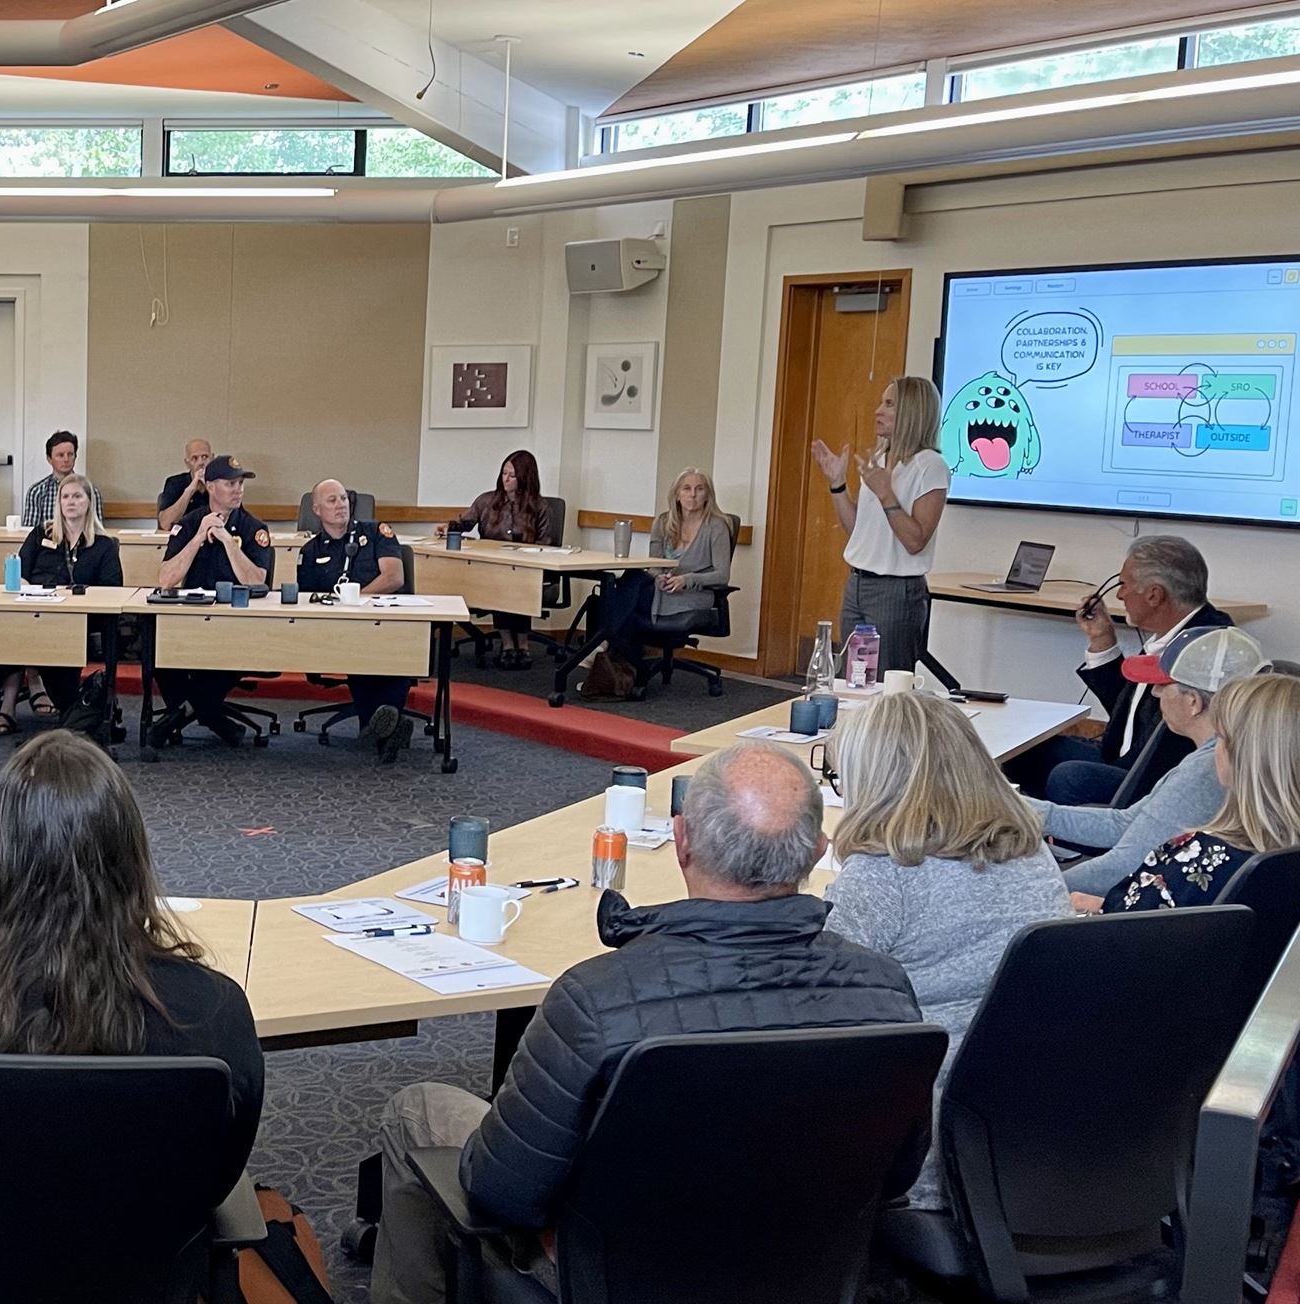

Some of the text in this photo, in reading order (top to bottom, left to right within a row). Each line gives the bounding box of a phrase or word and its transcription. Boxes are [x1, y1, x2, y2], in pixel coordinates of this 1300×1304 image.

[1016, 326, 1088, 336] COLLABORATION,
[1015, 338, 1078, 347] PARTNERSHIPS
[1013, 350, 1085, 359] COMMUNICATION
[1036, 362, 1062, 371] IS KEY
[1143, 382, 1179, 391] SCHOOL
[1230, 382, 1251, 392] SRO
[1133, 430, 1181, 440] THERAPIST
[1210, 432, 1251, 443] OUTSIDE
